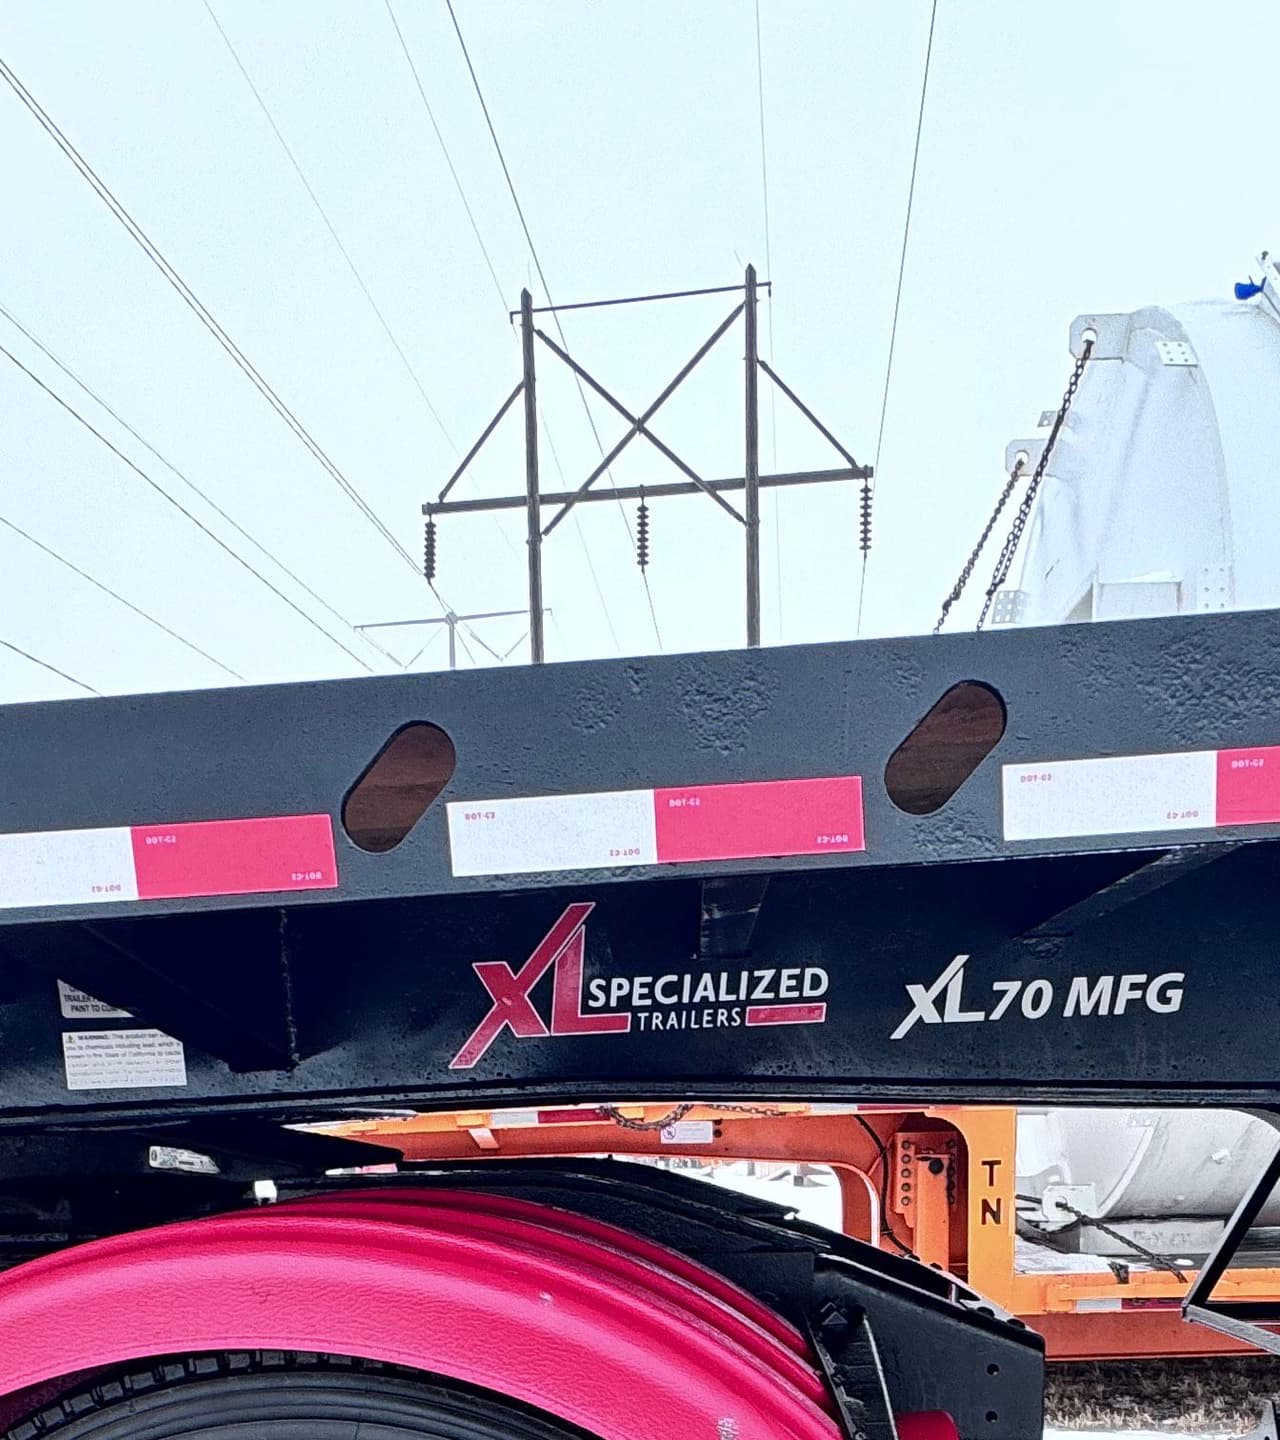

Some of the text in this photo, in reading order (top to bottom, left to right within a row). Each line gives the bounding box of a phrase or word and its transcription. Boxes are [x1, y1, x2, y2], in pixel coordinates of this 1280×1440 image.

[448, 901, 829, 1069] XL SPECIALIZED
[637, 1007, 741, 1032] TRAILERS
[890, 954, 1186, 1040] XL 70 MFG
